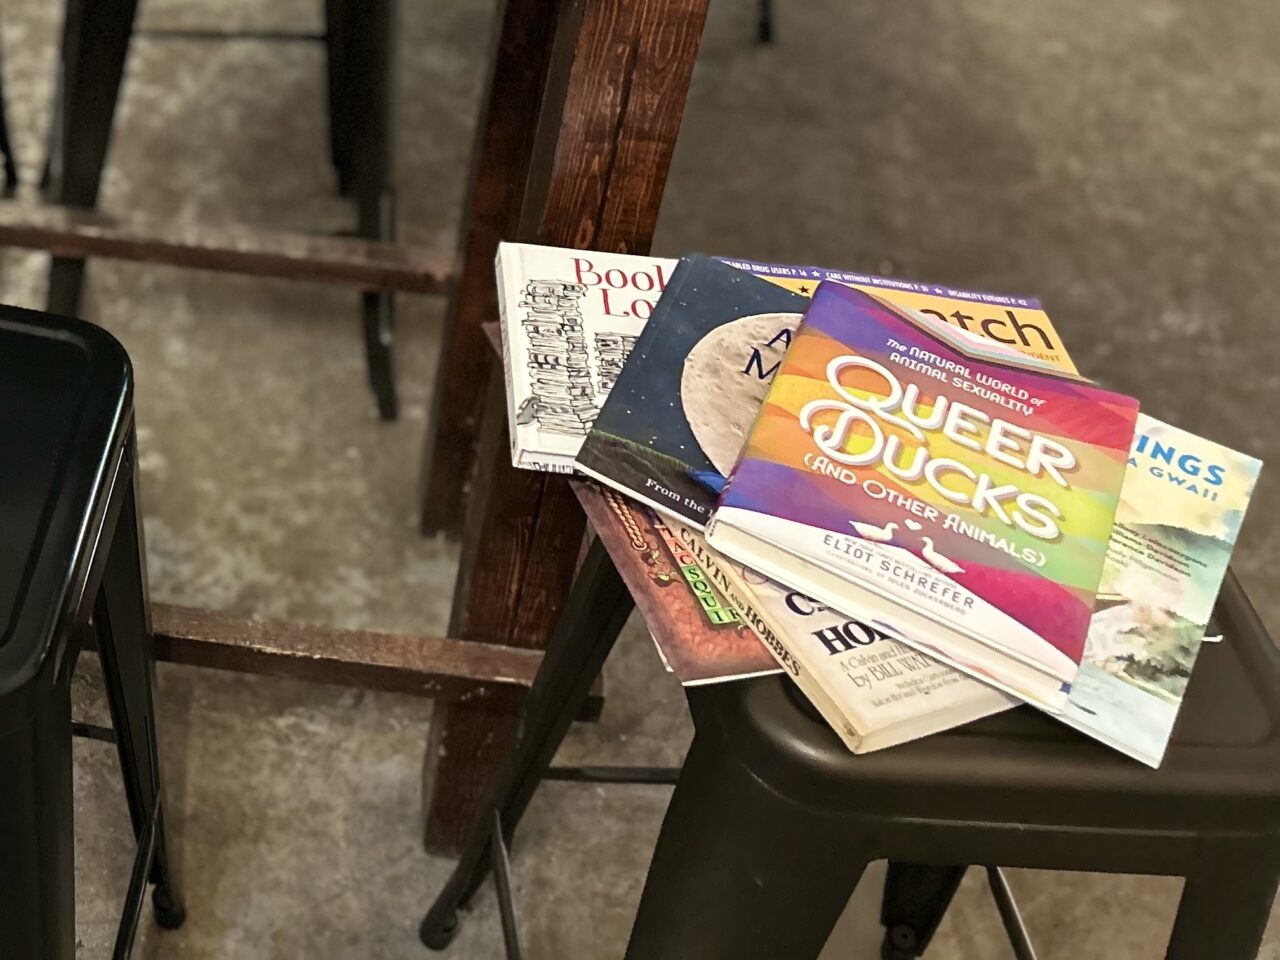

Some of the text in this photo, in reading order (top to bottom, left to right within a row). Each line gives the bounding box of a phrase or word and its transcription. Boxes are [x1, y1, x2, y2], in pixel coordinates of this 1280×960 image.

[751, 264, 770, 273] DRUG
[600, 288, 658, 320] Lo
[890, 352, 1035, 417] ANIMAL SEXUALITY
[909, 346, 972, 379] NATURAL
[976, 372, 1030, 400] WORLD
[1030, 397, 1047, 408] of
[826, 354, 1078, 488] QUEER
[645, 478, 686, 503] From
[684, 497, 706, 513] the
[800, 398, 1064, 540] DUCKS
[1149, 466, 1218, 502] GWAII
[804, 453, 1046, 568] (AND OTHER ANIMALS)
[680, 528, 802, 677] CALVIN AND HOBBES
[824, 534, 874, 564] ELIOT
[880, 560, 976, 609] SCHREFER
[848, 671, 872, 690] by
[869, 660, 903, 682] BILL
